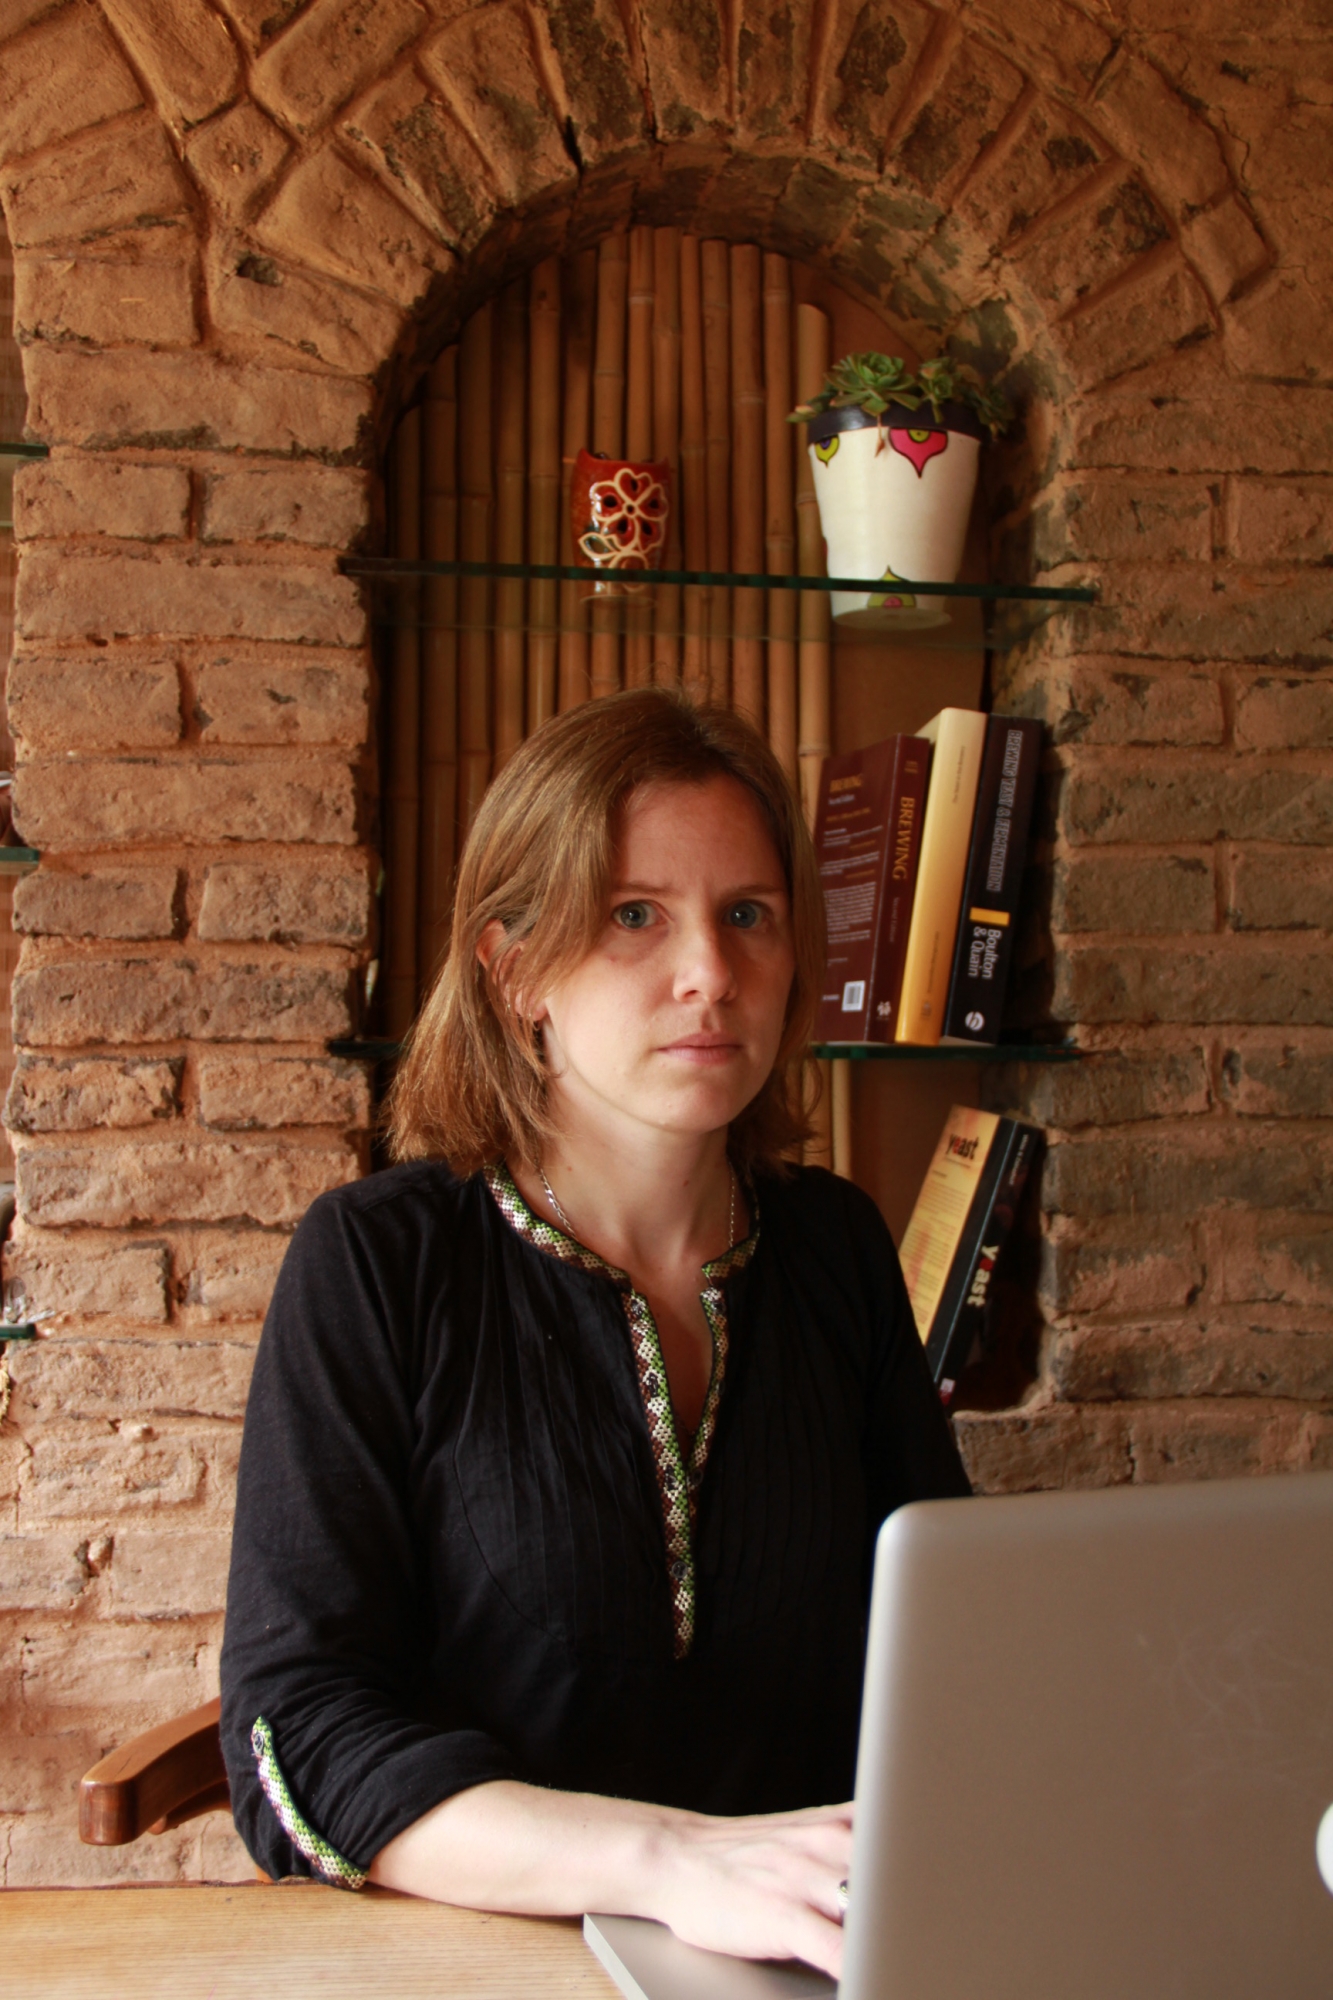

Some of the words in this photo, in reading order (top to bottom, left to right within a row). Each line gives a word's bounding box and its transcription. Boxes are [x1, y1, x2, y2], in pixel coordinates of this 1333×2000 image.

[1002, 729, 1023, 777] BREWING
[998, 777, 1017, 807] YEAST
[996, 807, 1011, 818] &
[892, 797, 915, 880] BREWING
[986, 817, 1011, 892] FERMENTATION
[973, 926, 987, 936] &
[968, 940, 986, 977] Quain
[982, 929, 1002, 979] Boulton
[946, 1133, 979, 1160] yeast
